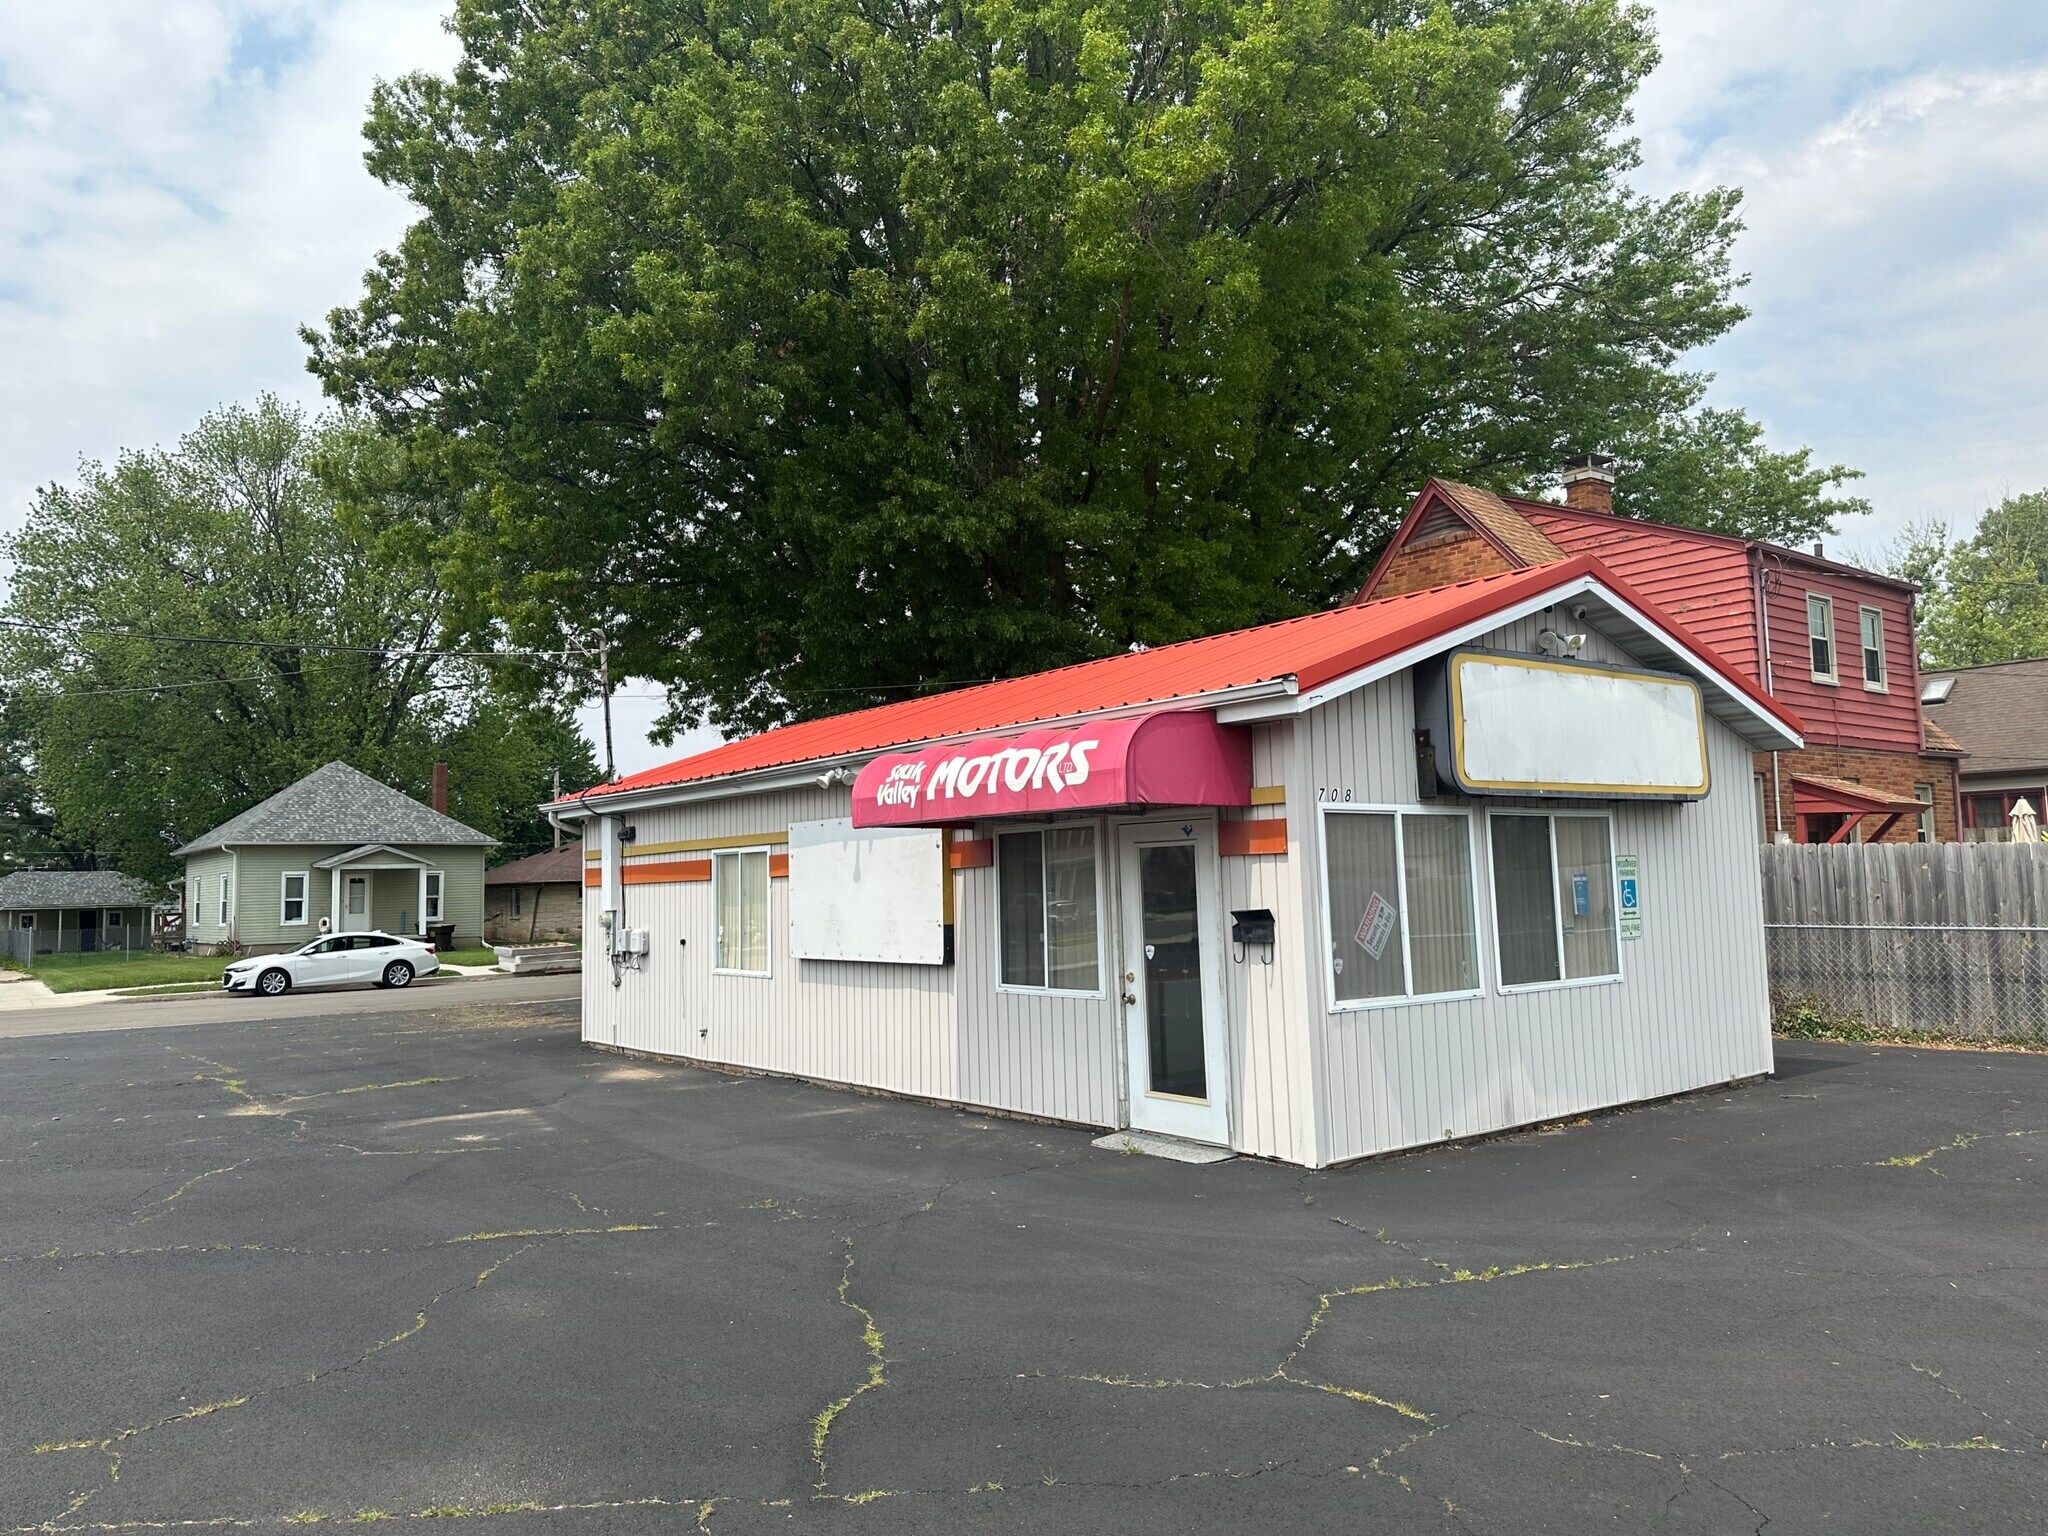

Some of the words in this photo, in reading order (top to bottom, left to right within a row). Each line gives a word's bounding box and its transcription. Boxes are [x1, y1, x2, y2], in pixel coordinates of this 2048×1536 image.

[926, 739, 1100, 800] MOTORS
[876, 780, 921, 809] Valley
[1318, 787, 1352, 803] 708
[1359, 898, 1379, 939] WARNING
[1367, 922, 1381, 946] Security
[1373, 930, 1386, 952] Cameras
